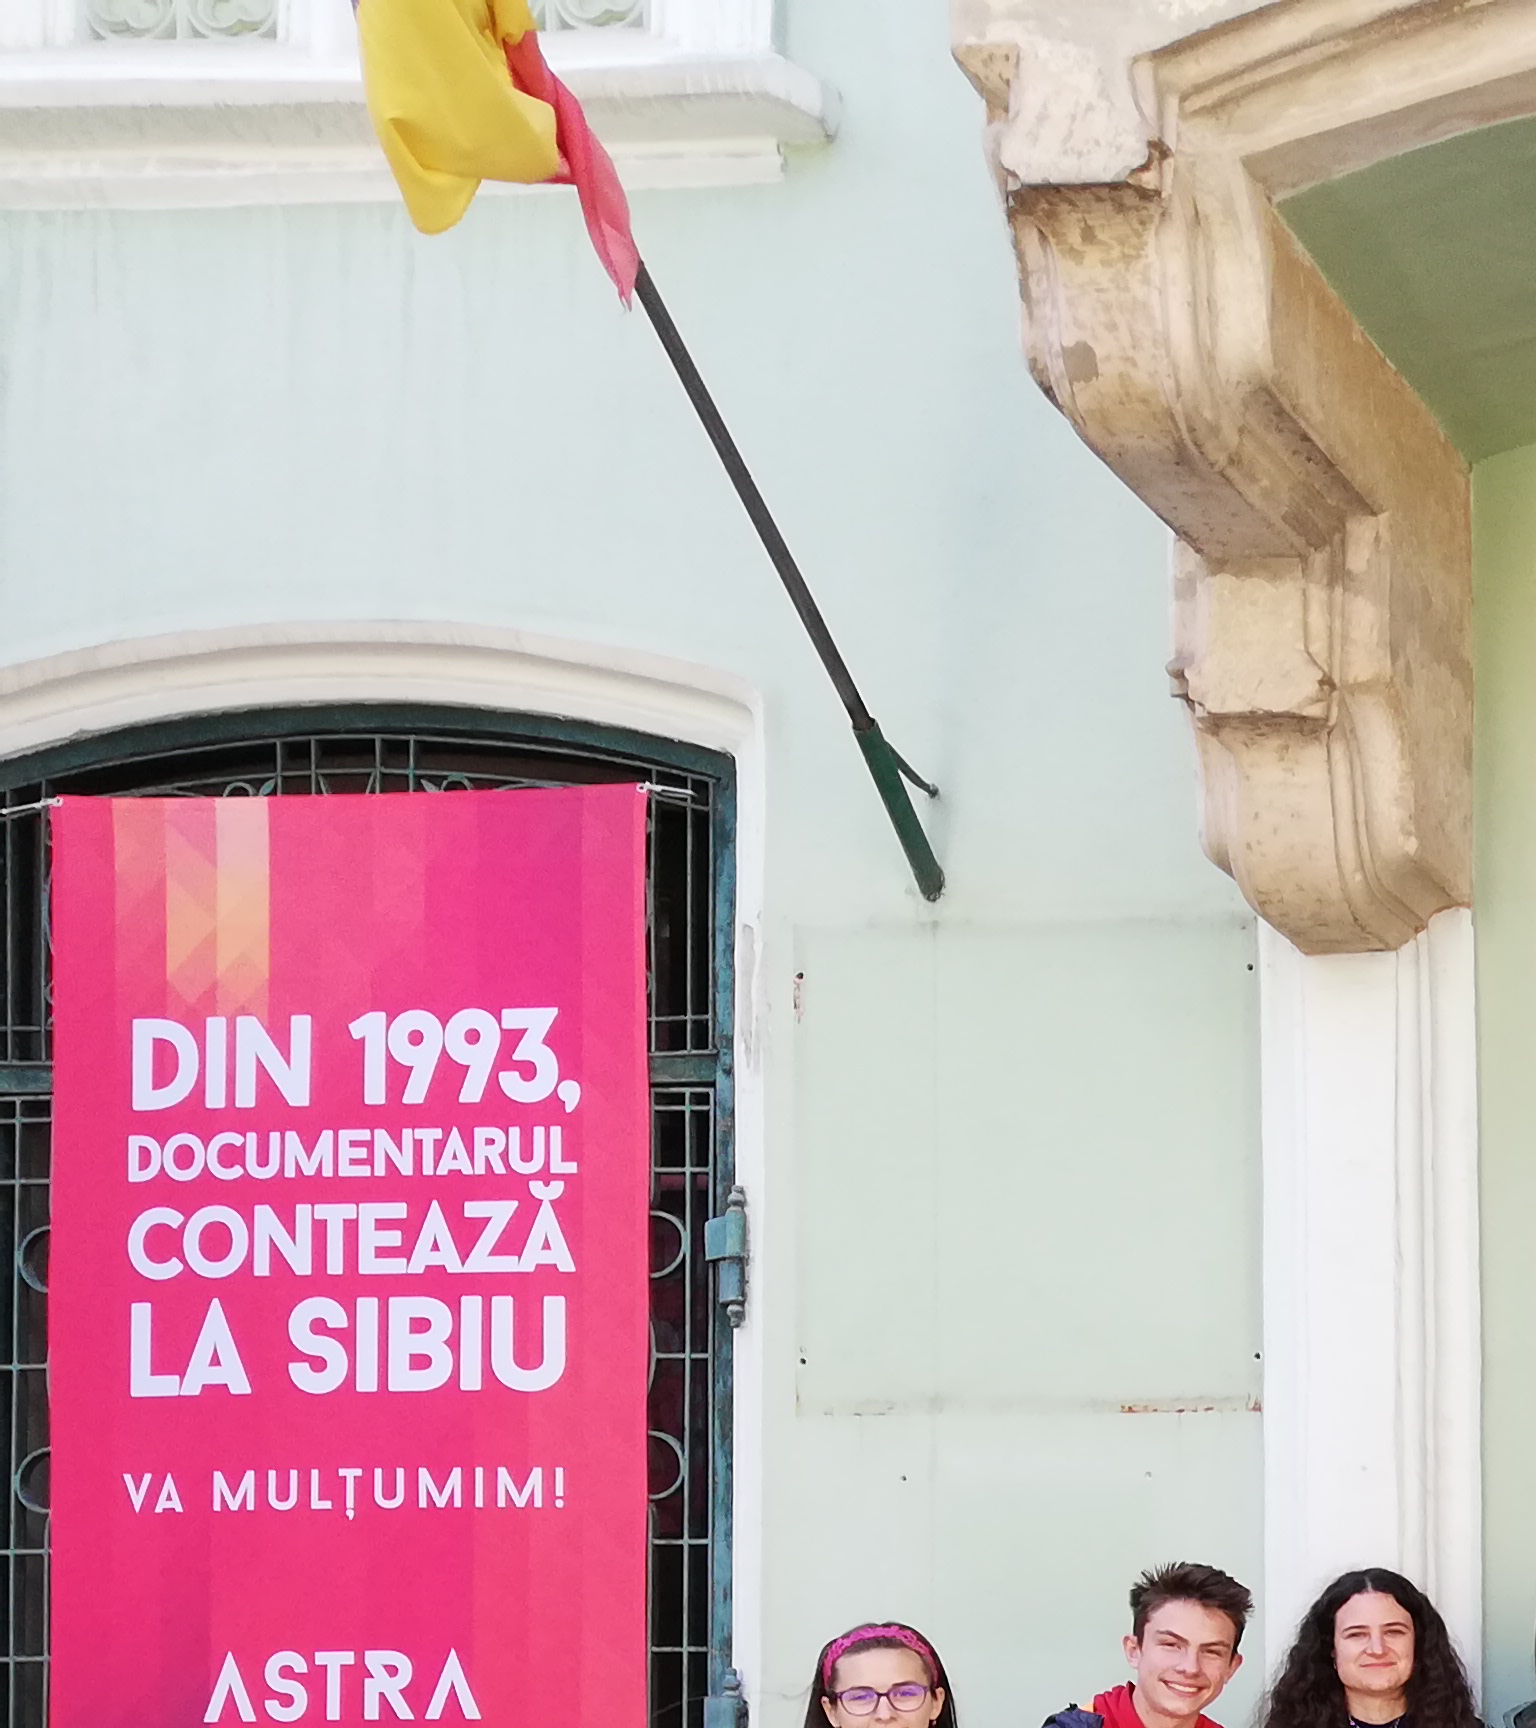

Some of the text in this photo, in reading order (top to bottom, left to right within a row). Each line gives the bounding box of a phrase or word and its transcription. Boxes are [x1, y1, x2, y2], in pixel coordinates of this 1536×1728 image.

[132, 1007, 581, 1113] DIN 1993,
[128, 1126, 577, 1183] DOCUMENTARUL
[128, 1178, 576, 1280] CONTEAZĂ
[130, 1296, 566, 1397] LA SIBIU
[123, 1473, 183, 1513] VA
[204, 1649, 481, 1722] ASTRA
